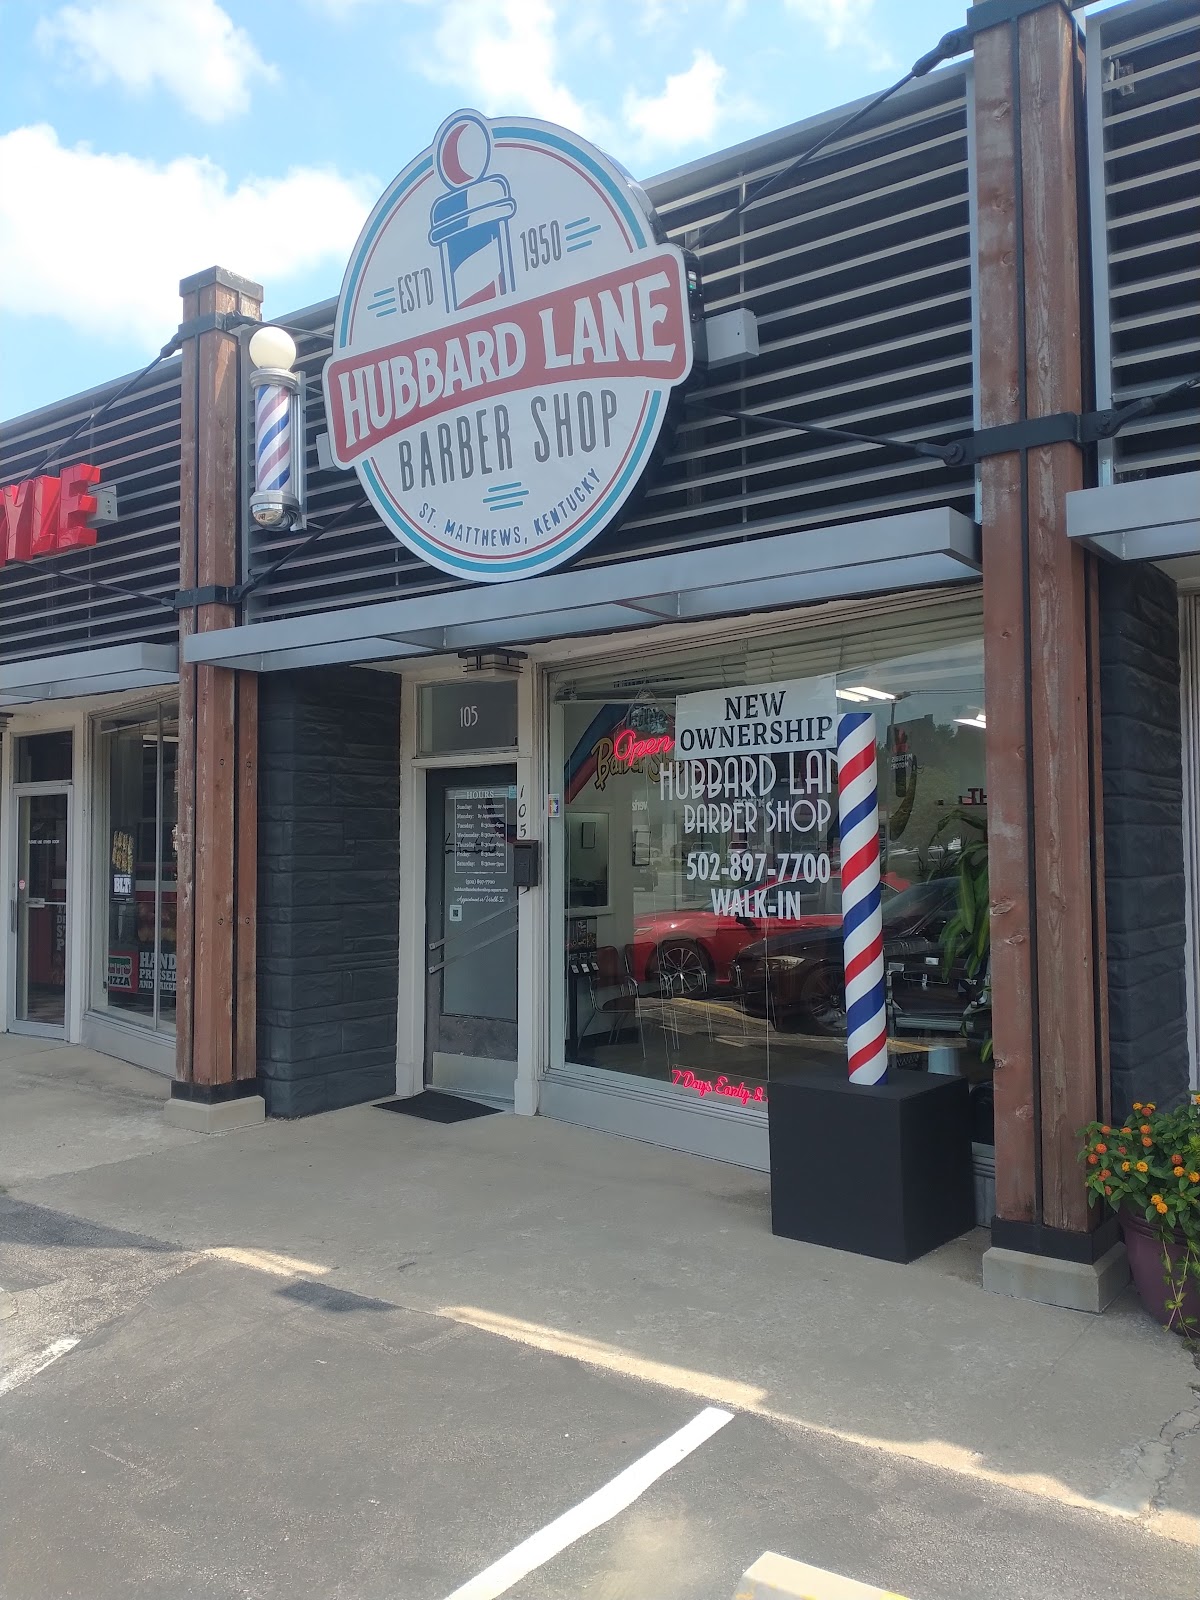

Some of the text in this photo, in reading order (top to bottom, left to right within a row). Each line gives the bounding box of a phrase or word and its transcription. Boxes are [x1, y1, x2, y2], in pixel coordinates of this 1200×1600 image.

[520, 220, 561, 272] 1950
[397, 267, 435, 315] EST'D
[337, 270, 677, 449] HUBBARD LANE
[398, 389, 618, 492] BARBER SHOP
[0, 463, 101, 567] YLE
[418, 467, 600, 547] ST. MATTHEWS, KENTUCKY
[459, 705, 479, 728] 105
[724, 690, 787, 721] NEW
[613, 729, 675, 767] Open
[680, 716, 833, 751] OWNERSHIP
[659, 749, 839, 800] HUBBARD LAN
[466, 790, 495, 799] HOURS
[518, 785, 527, 839] 105
[684, 799, 832, 834] BARBER SHOP
[686, 853, 831, 883] 502-897-7700
[711, 888, 801, 920] WALK-IN
[108, 976, 131, 986] IZZA
[139, 980, 154, 989] AND
[671, 1069, 681, 1086] 7
[681, 1070, 713, 1097] Days
[714, 1075, 752, 1105] Early
[753, 1086, 764, 1102] &
